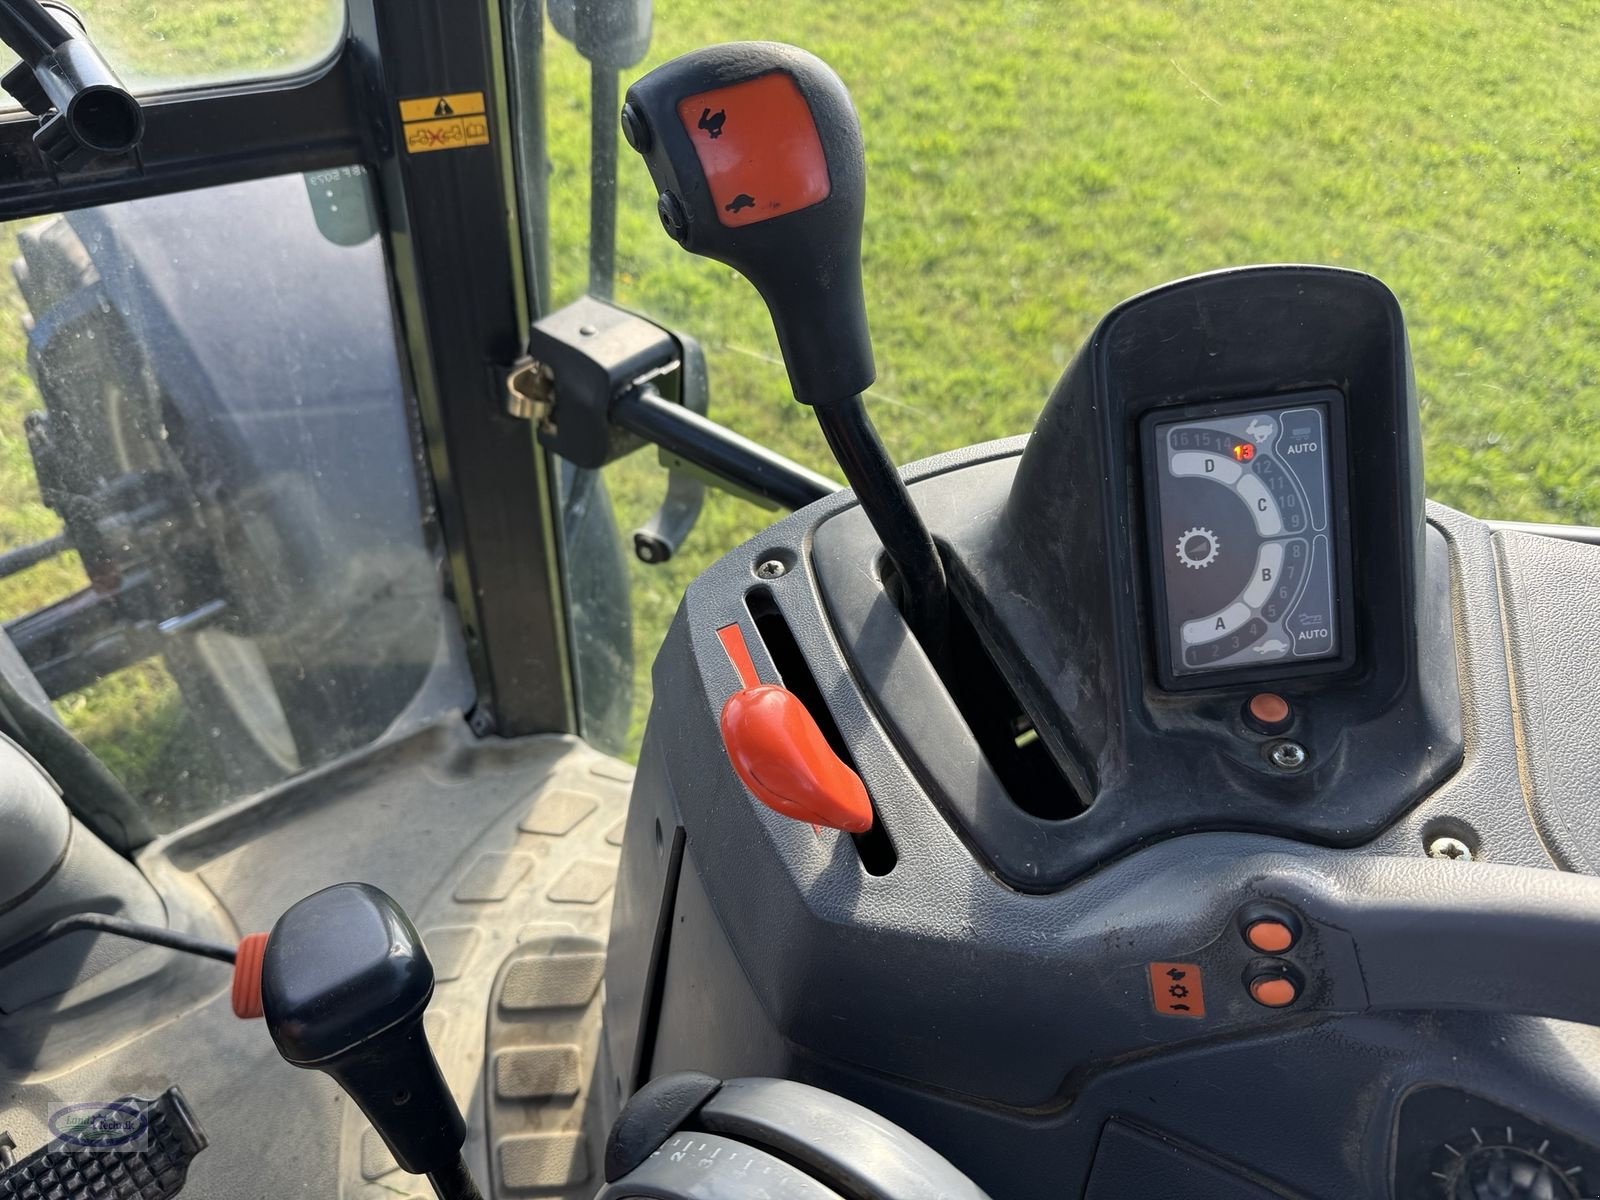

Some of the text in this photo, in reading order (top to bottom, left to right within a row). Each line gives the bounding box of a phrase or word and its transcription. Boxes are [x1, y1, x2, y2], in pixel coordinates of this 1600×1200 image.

[1172, 433, 1189, 446] 16
[1194, 433, 1211, 446] 15
[1233, 444, 1255, 461] 13
[1287, 442, 1318, 454] AUTO
[1205, 459, 1215, 472] D
[1256, 460, 1272, 474] 12
[1269, 476, 1284, 489] 11
[1257, 498, 1267, 511] C
[1279, 495, 1295, 508] 10
[1291, 514, 1300, 528] 9
[1292, 545, 1301, 558] 8
[1262, 568, 1271, 581] B
[1288, 566, 1295, 579] 7
[1280, 585, 1288, 599] 6
[1267, 604, 1276, 617] 5
[1215, 617, 1225, 630] A
[1249, 622, 1257, 635] 4
[1299, 628, 1328, 640] AUTO
[1232, 635, 1240, 649] 3
[1211, 644, 1219, 658] 2
[670, 1152, 686, 1162] 2
